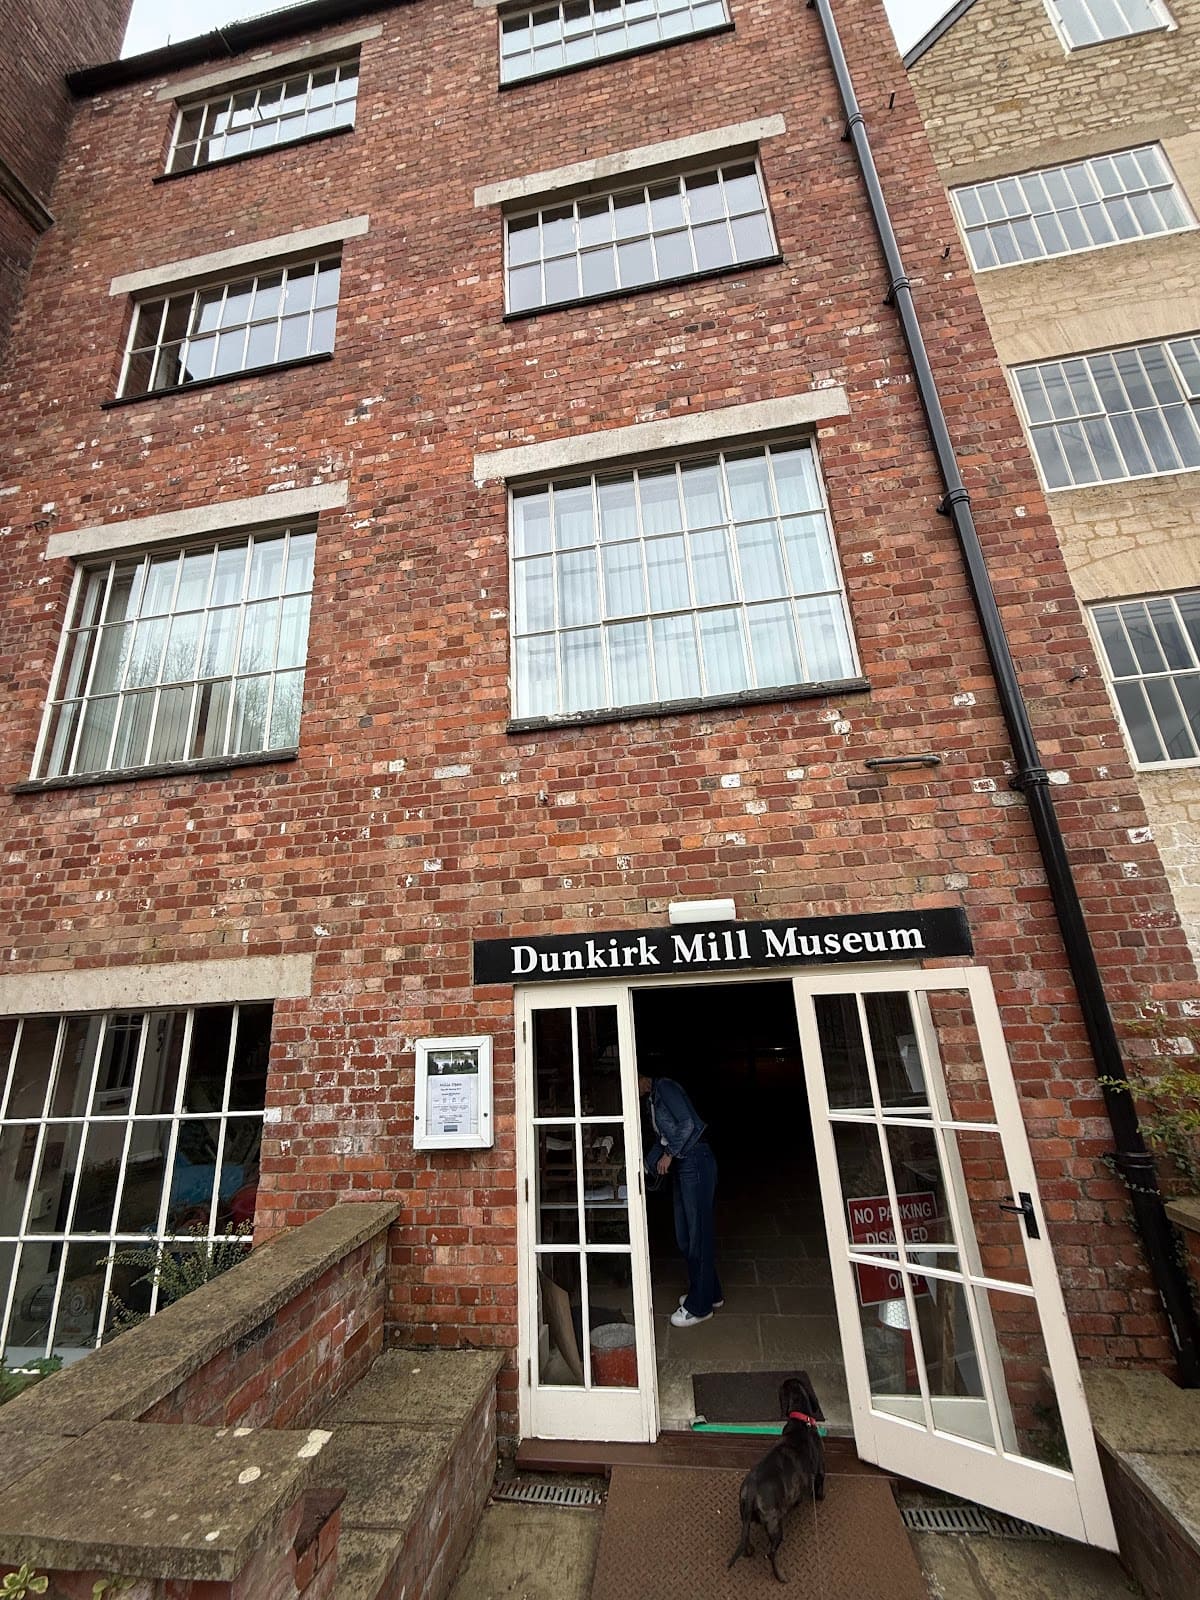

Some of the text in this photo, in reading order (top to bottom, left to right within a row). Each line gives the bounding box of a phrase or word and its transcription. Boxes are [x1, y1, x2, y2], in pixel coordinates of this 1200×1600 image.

[511, 926, 926, 974] Dunkirk Mill Museum
[853, 1202, 932, 1225] NO PAKING
[866, 1226, 928, 1245] DISALED
